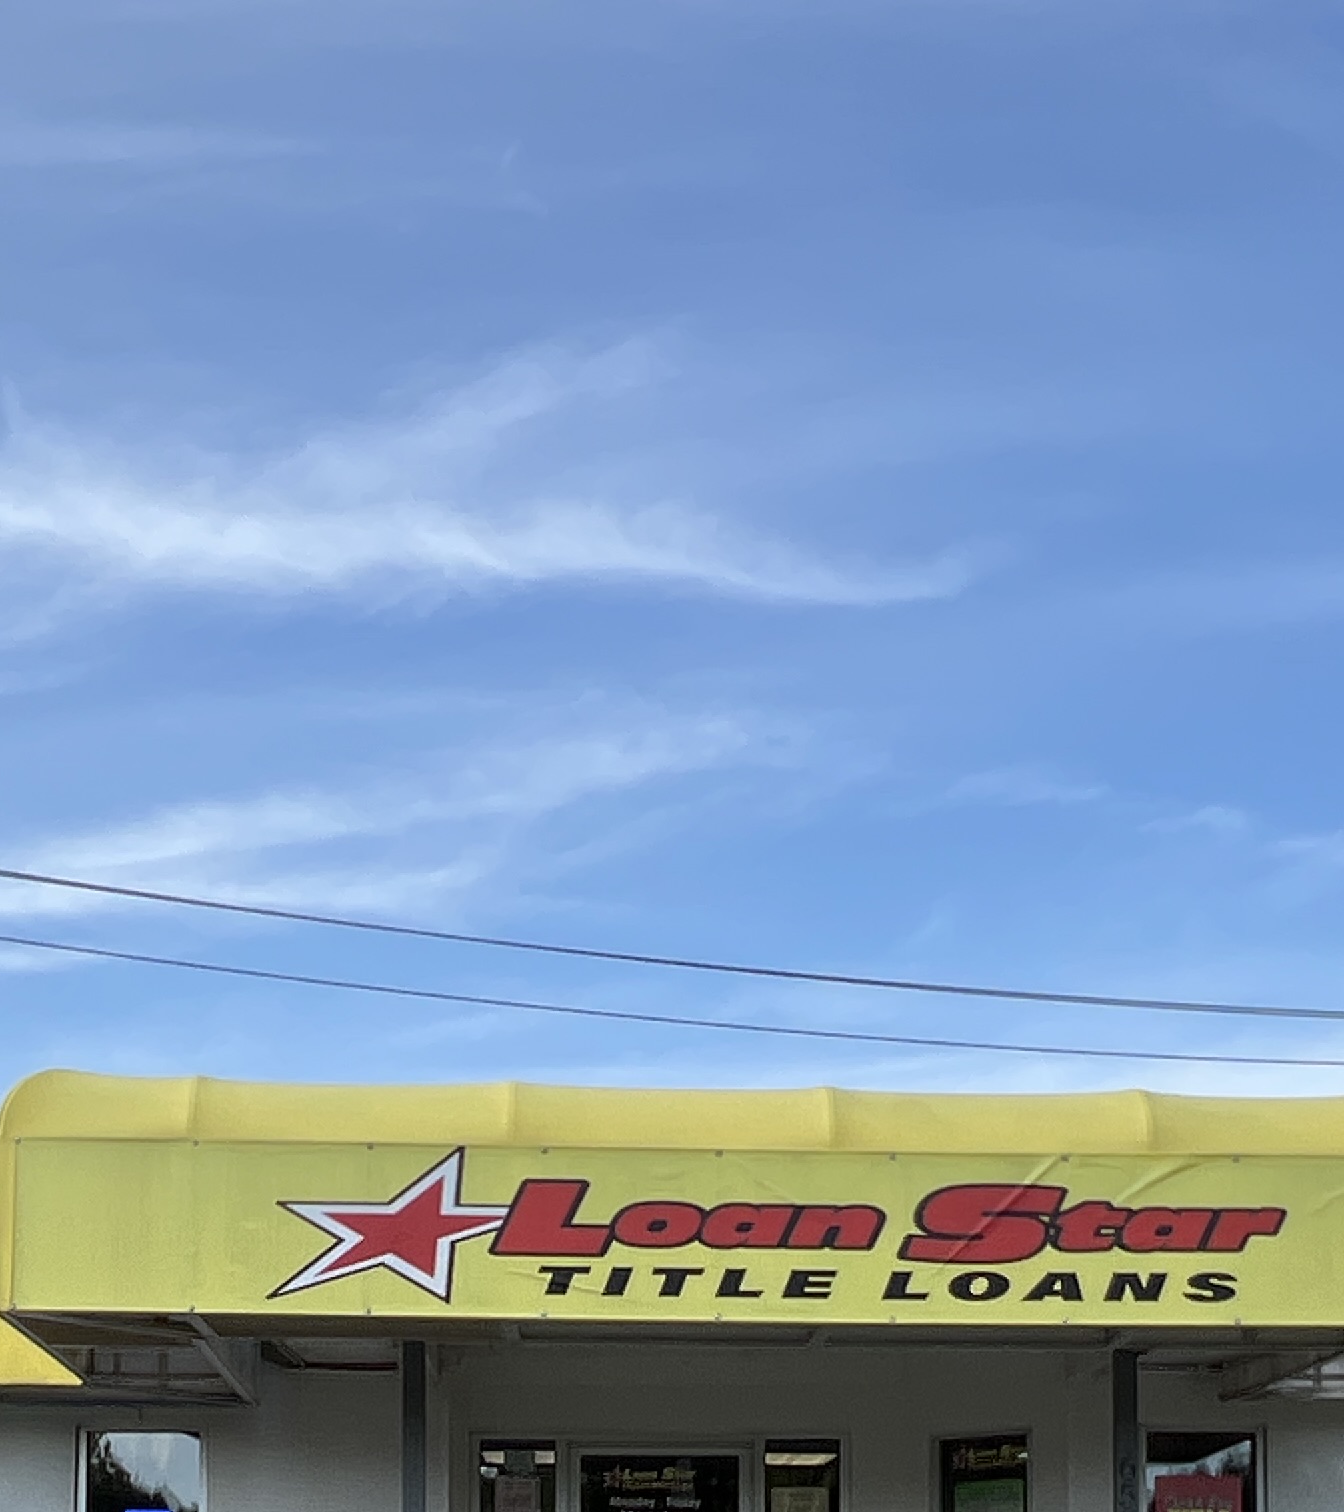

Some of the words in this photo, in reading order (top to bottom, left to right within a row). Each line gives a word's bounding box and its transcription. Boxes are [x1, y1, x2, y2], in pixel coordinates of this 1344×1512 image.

[488, 1178, 886, 1257] Loan
[897, 1183, 1288, 1263] Star
[539, 1266, 838, 1299] TITLE
[882, 1270, 1239, 1302] LOANS
